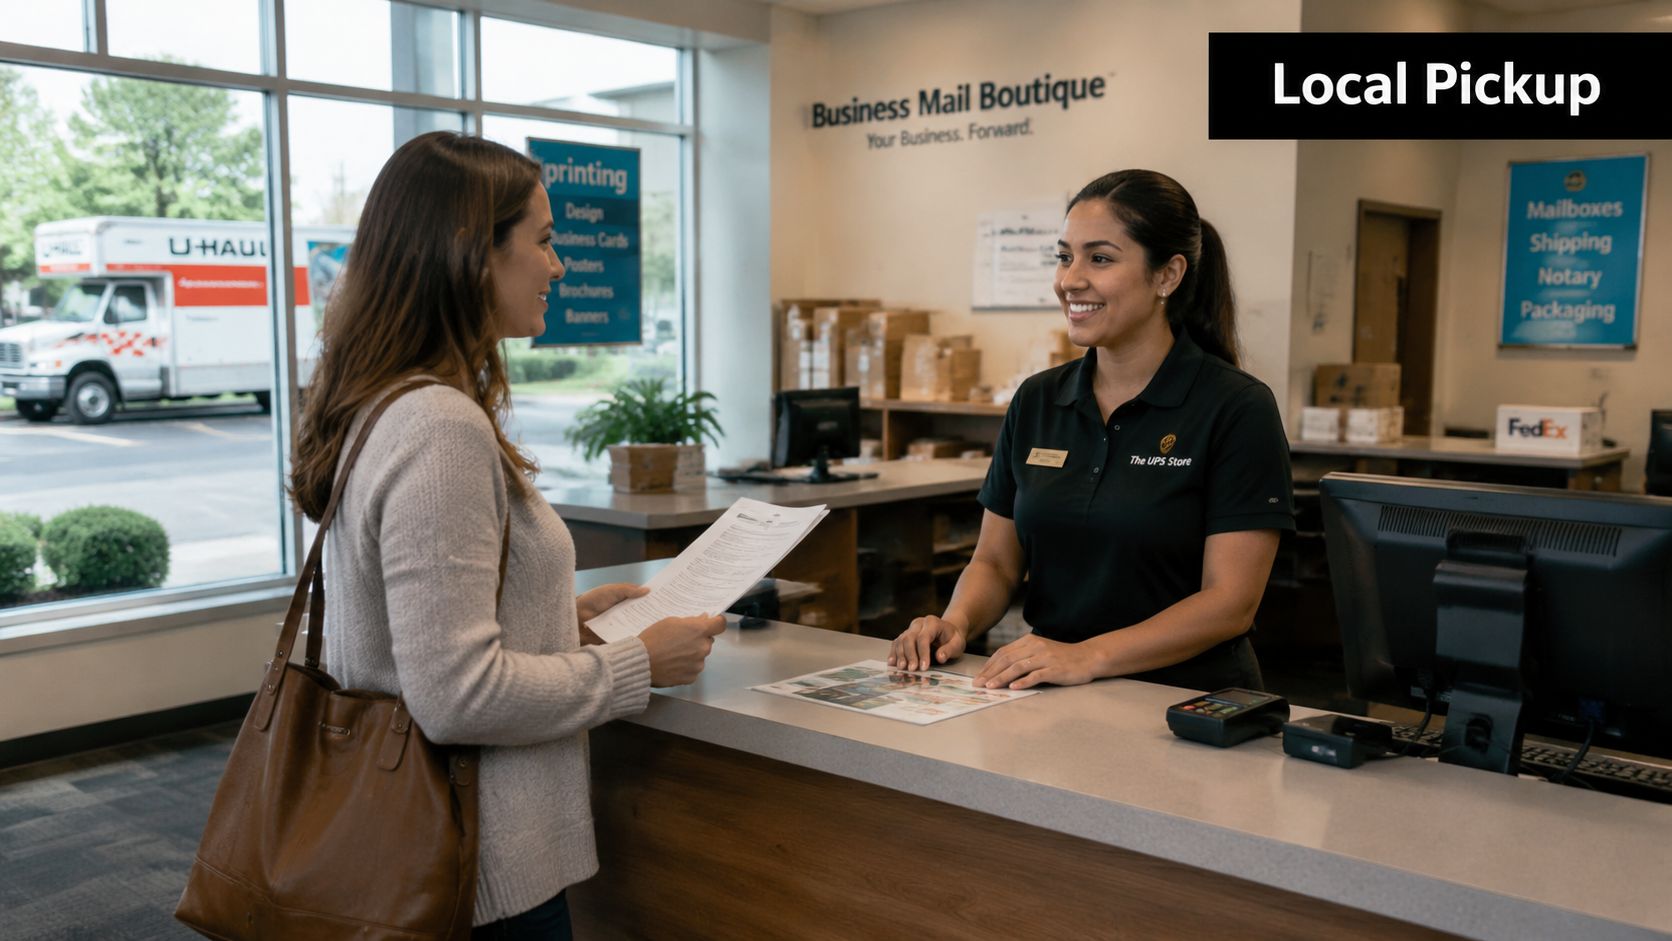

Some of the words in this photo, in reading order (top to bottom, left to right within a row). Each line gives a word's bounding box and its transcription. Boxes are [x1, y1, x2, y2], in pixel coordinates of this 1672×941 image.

[812, 96, 910, 128] Business
[918, 83, 970, 116] Mail
[979, 73, 1105, 111] Boutique
[867, 133, 896, 150] Your
[901, 128, 963, 146] Business.
[544, 157, 628, 195] printing
[565, 202, 604, 223] Design
[1527, 199, 1623, 219] Mailboxes
[598, 232, 629, 249] Cards
[1530, 232, 1612, 254] Shipping
[564, 256, 604, 273] Posters
[1538, 267, 1602, 288] Notary
[559, 283, 614, 299] Brochures
[565, 308, 609, 324] Banners
[1521, 301, 1616, 324] Packaging
[1508, 418, 1568, 439] FedEx
[1130, 455, 1146, 465] The
[1147, 456, 1166, 466] UPS
[1168, 456, 1192, 467] Store
